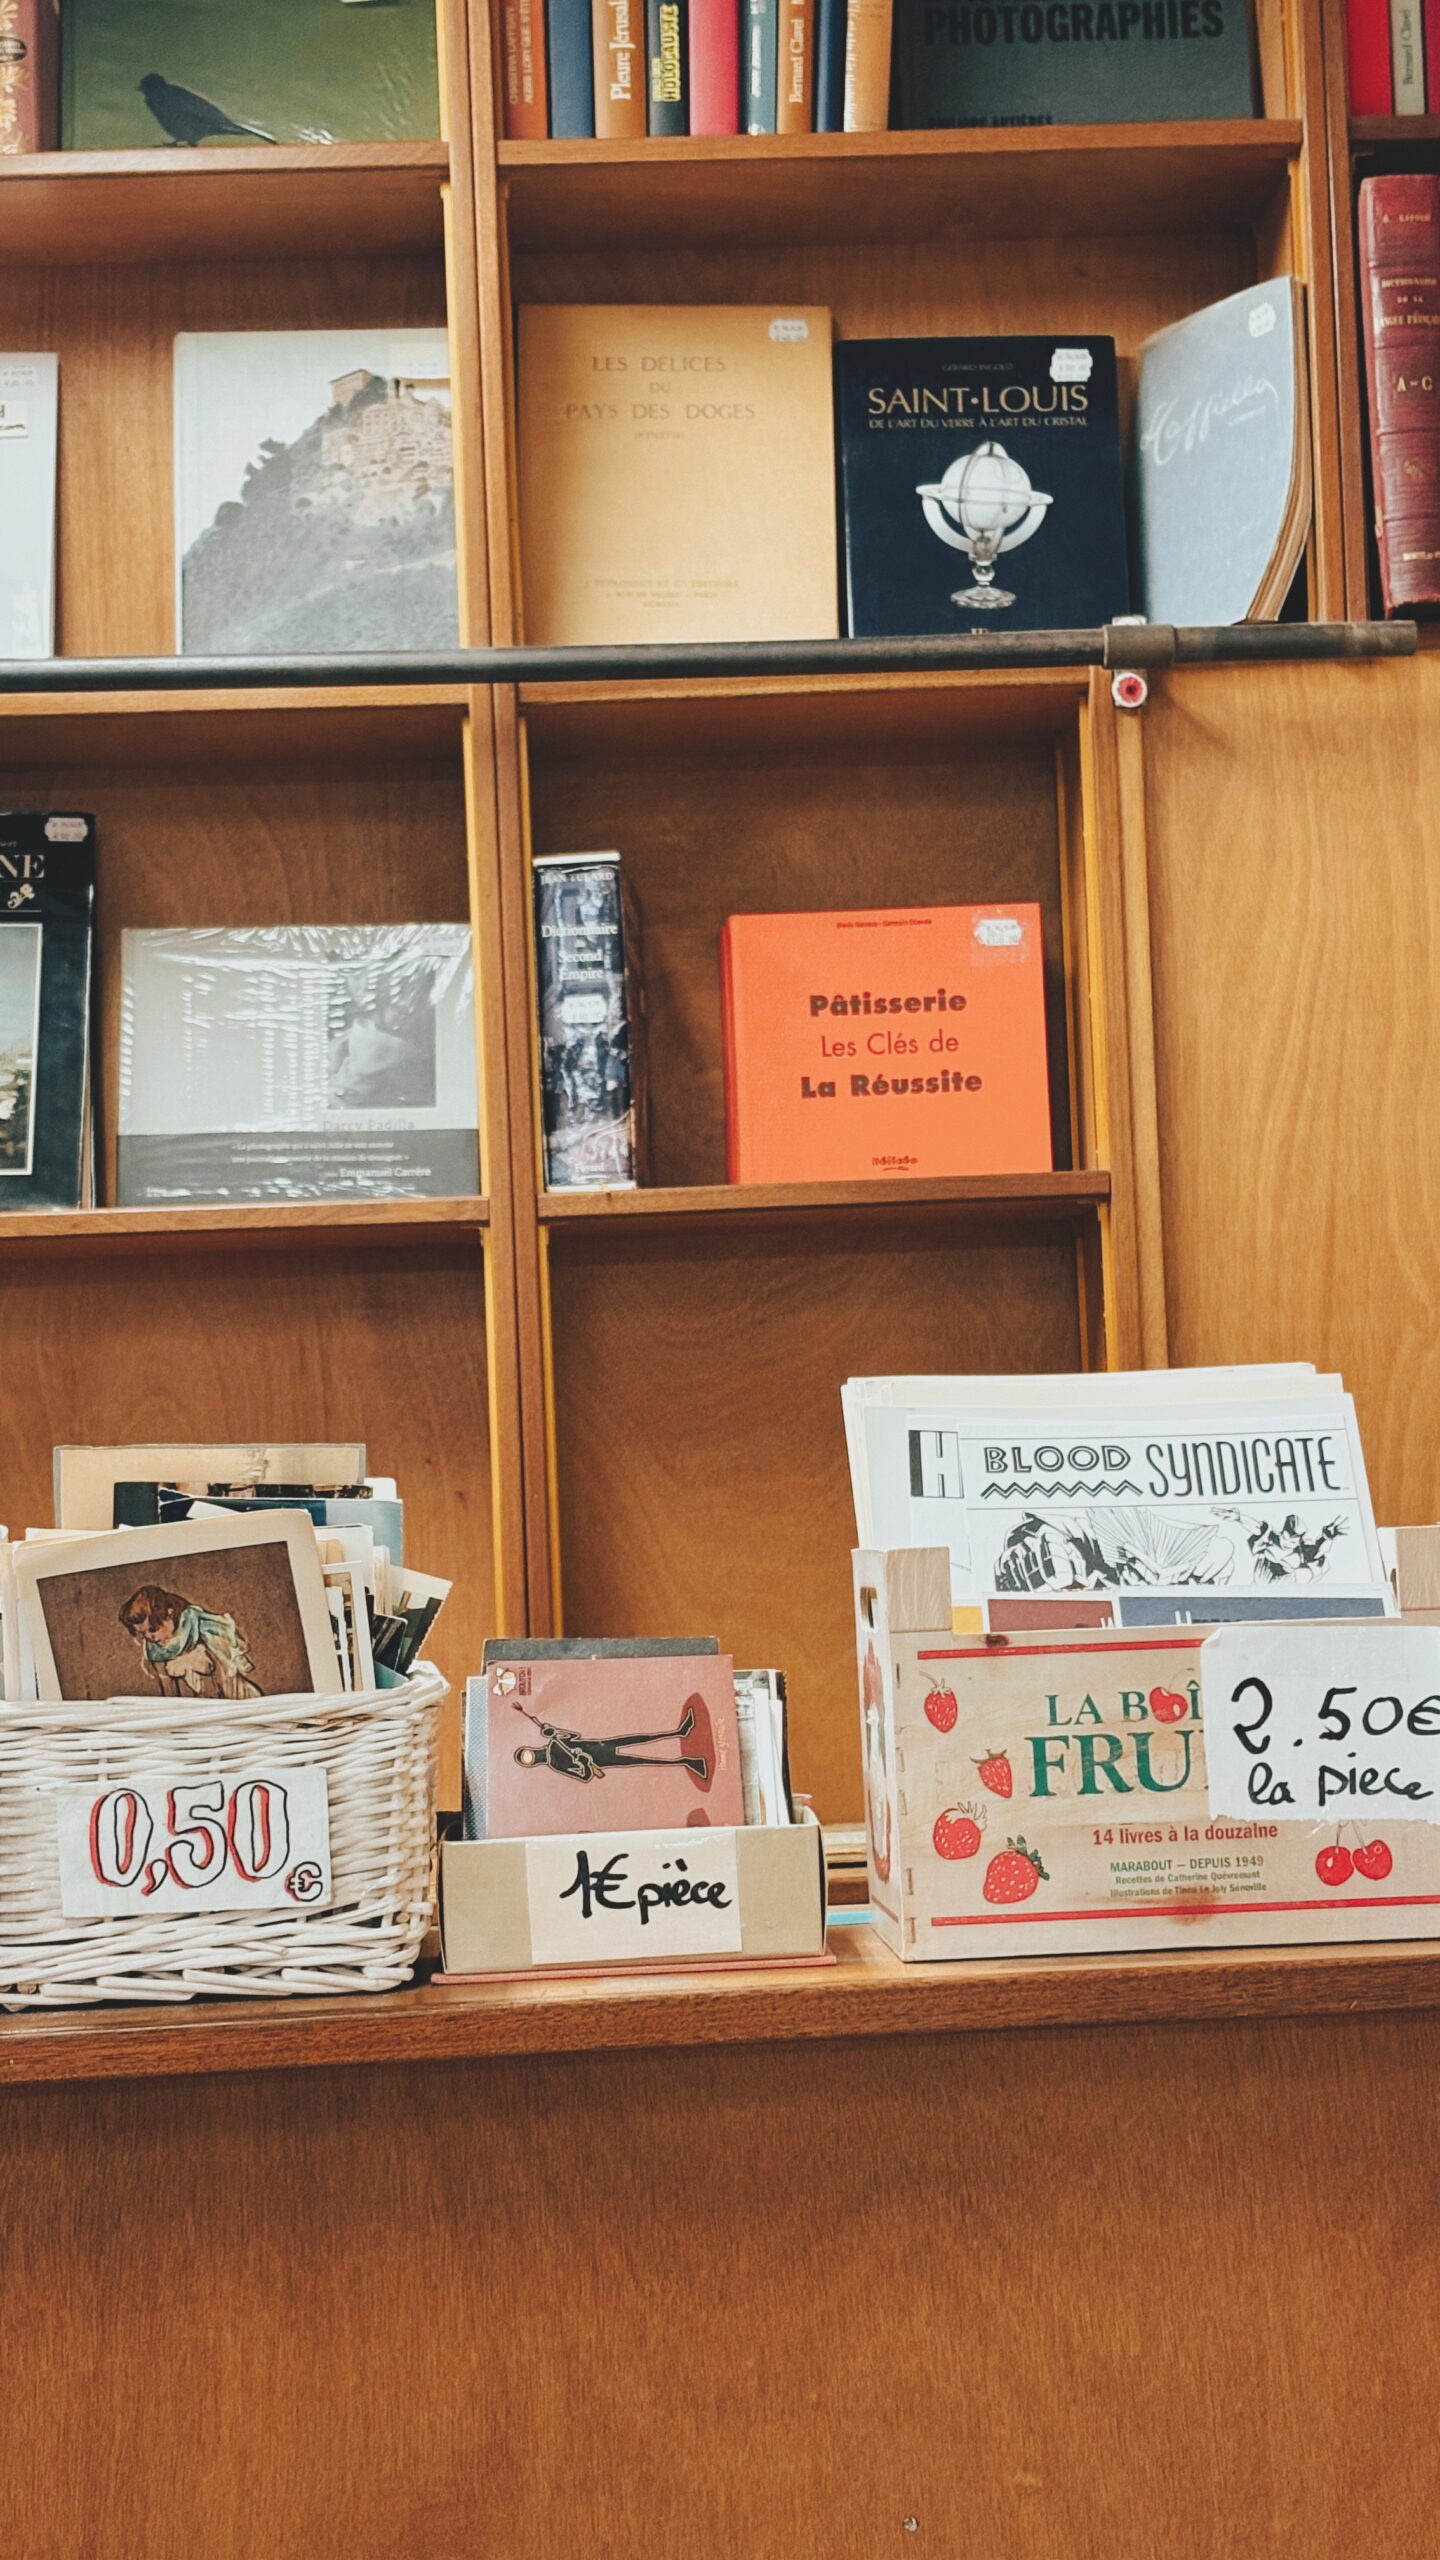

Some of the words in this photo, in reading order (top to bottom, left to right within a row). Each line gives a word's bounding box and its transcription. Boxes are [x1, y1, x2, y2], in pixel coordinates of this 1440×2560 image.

[925, 0, 1223, 45] PHOTOGRAPHIES
[661, 4, 681, 101] HOLOCAUSTE
[610, 52, 631, 100] Pleure
[789, 55, 804, 103] Bernard
[592, 356, 628, 372] LES
[641, 354, 726, 372] DÉLICES
[649, 382, 671, 393] DU
[566, 403, 617, 419] PAYS
[632, 403, 670, 419] DES
[686, 403, 755, 419] DOGES
[869, 418, 885, 428] DE
[921, 418, 939, 428] DU
[941, 418, 975, 428] VERRE
[1044, 416, 1088, 427] CRISTAL
[542, 925, 618, 938] Dictionnaire
[558, 949, 603, 963] Second
[558, 968, 604, 982] Empire
[810, 988, 967, 1017] Pâtisserie
[821, 1035, 857, 1057] Les
[867, 1031, 918, 1055] Clés
[929, 1028, 959, 1053] de
[801, 1076, 836, 1098] La
[850, 1069, 982, 1097] Réussite
[340, 1168, 393, 1179] Emmanuel
[394, 1167, 431, 1178] Carrère
[984, 1445, 1131, 1473] BLOOD
[1045, 1692, 1104, 1726] LA
[1024, 1730, 1207, 1797] FRU
[1248, 1762, 1296, 1805] la
[1093, 1828, 1113, 1845] 14
[1120, 1828, 1162, 1844] livres
[1168, 1825, 1178, 1841] à
[1184, 1826, 1199, 1841] la
[1205, 1823, 1278, 1840] douzaine
[1110, 1860, 1173, 1873] MARABOUT
[1190, 1857, 1231, 1869] DEPUIS
[1235, 1856, 1264, 1867] 1949
[559, 1850, 636, 1918] 1€
[637, 1858, 732, 1925] pièce
[1115, 1876, 1152, 1884] Recettes
[1155, 1875, 1165, 1883] de
[1168, 1873, 1208, 1882] Catherine
[1110, 1887, 1160, 1897] Illustrations
[1162, 1887, 1173, 1895] de
